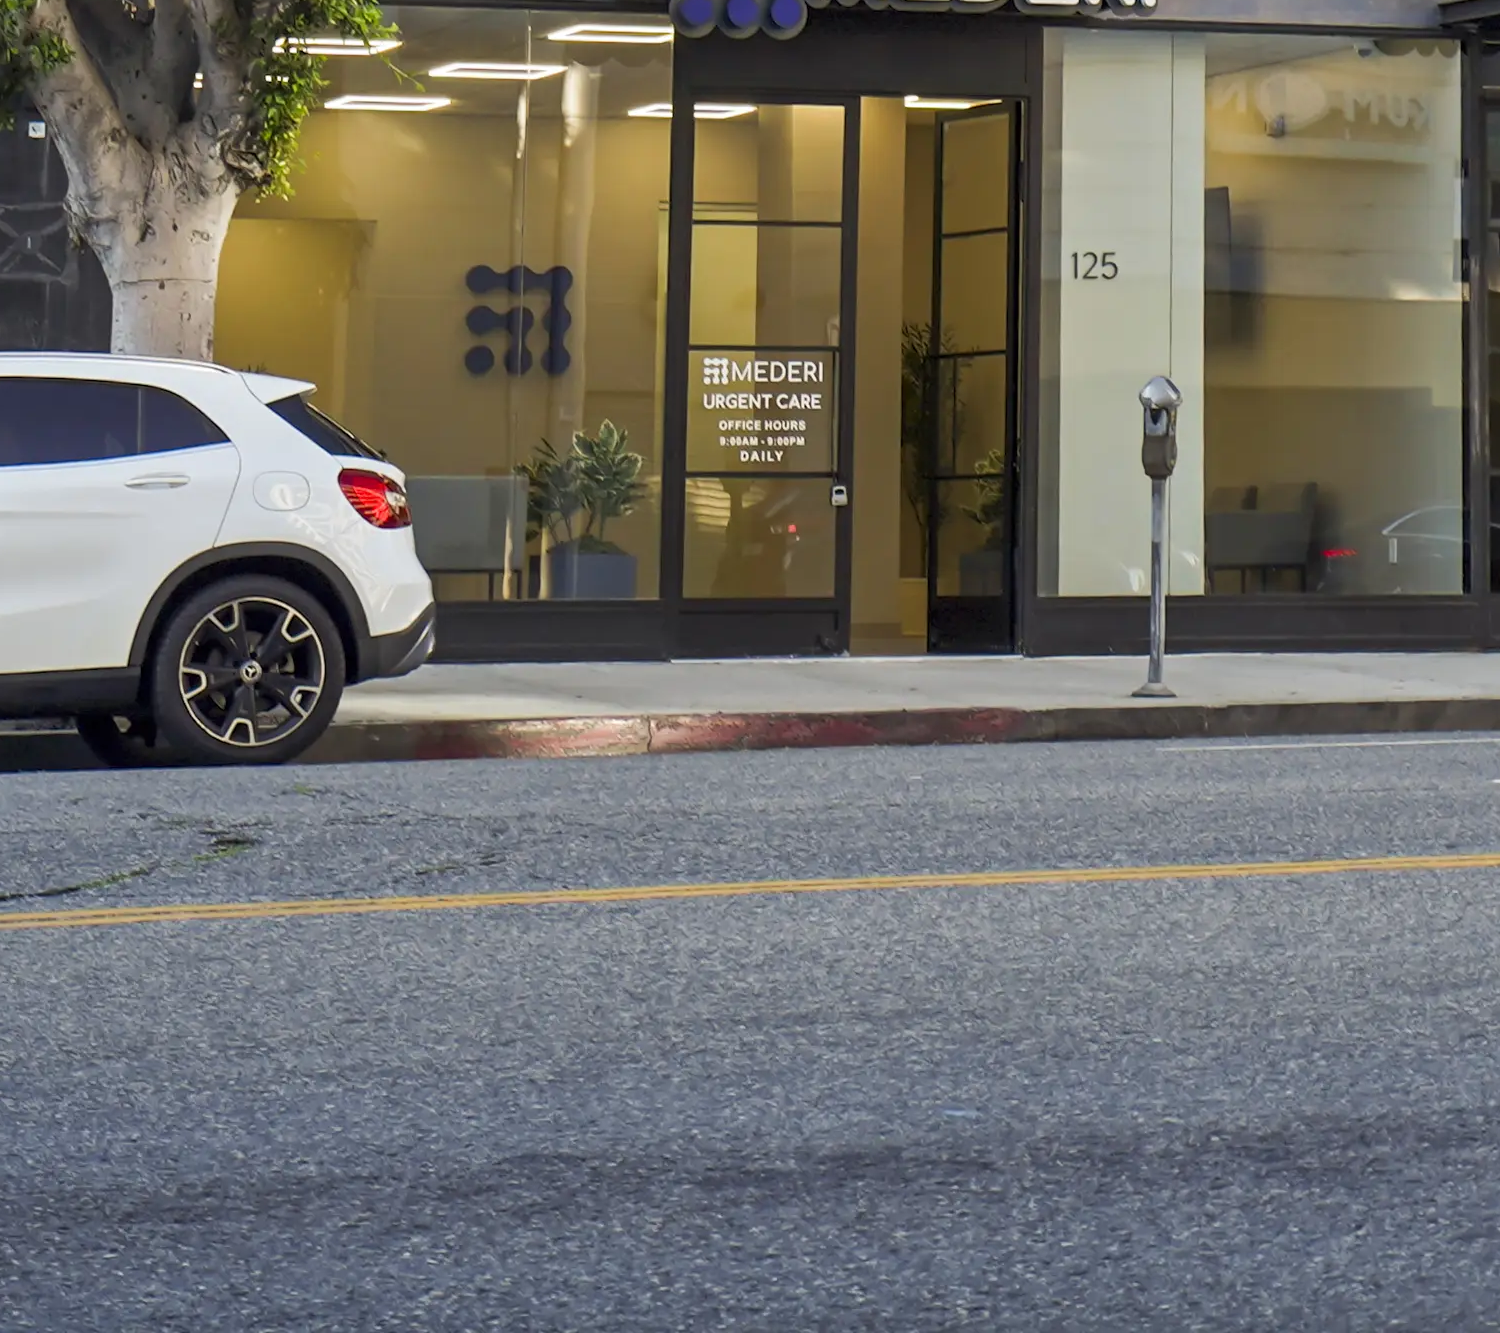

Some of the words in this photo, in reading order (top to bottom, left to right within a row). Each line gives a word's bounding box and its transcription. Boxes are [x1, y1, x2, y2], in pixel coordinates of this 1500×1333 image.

[1071, 251, 1119, 280] 125
[731, 360, 824, 383] MEDERI
[703, 393, 773, 410] URGENT
[776, 393, 822, 410] CARE
[718, 419, 762, 432] OFFICE
[764, 419, 806, 432] HOURS
[766, 436, 805, 447] 9:00PM
[739, 450, 784, 463] DAILY
